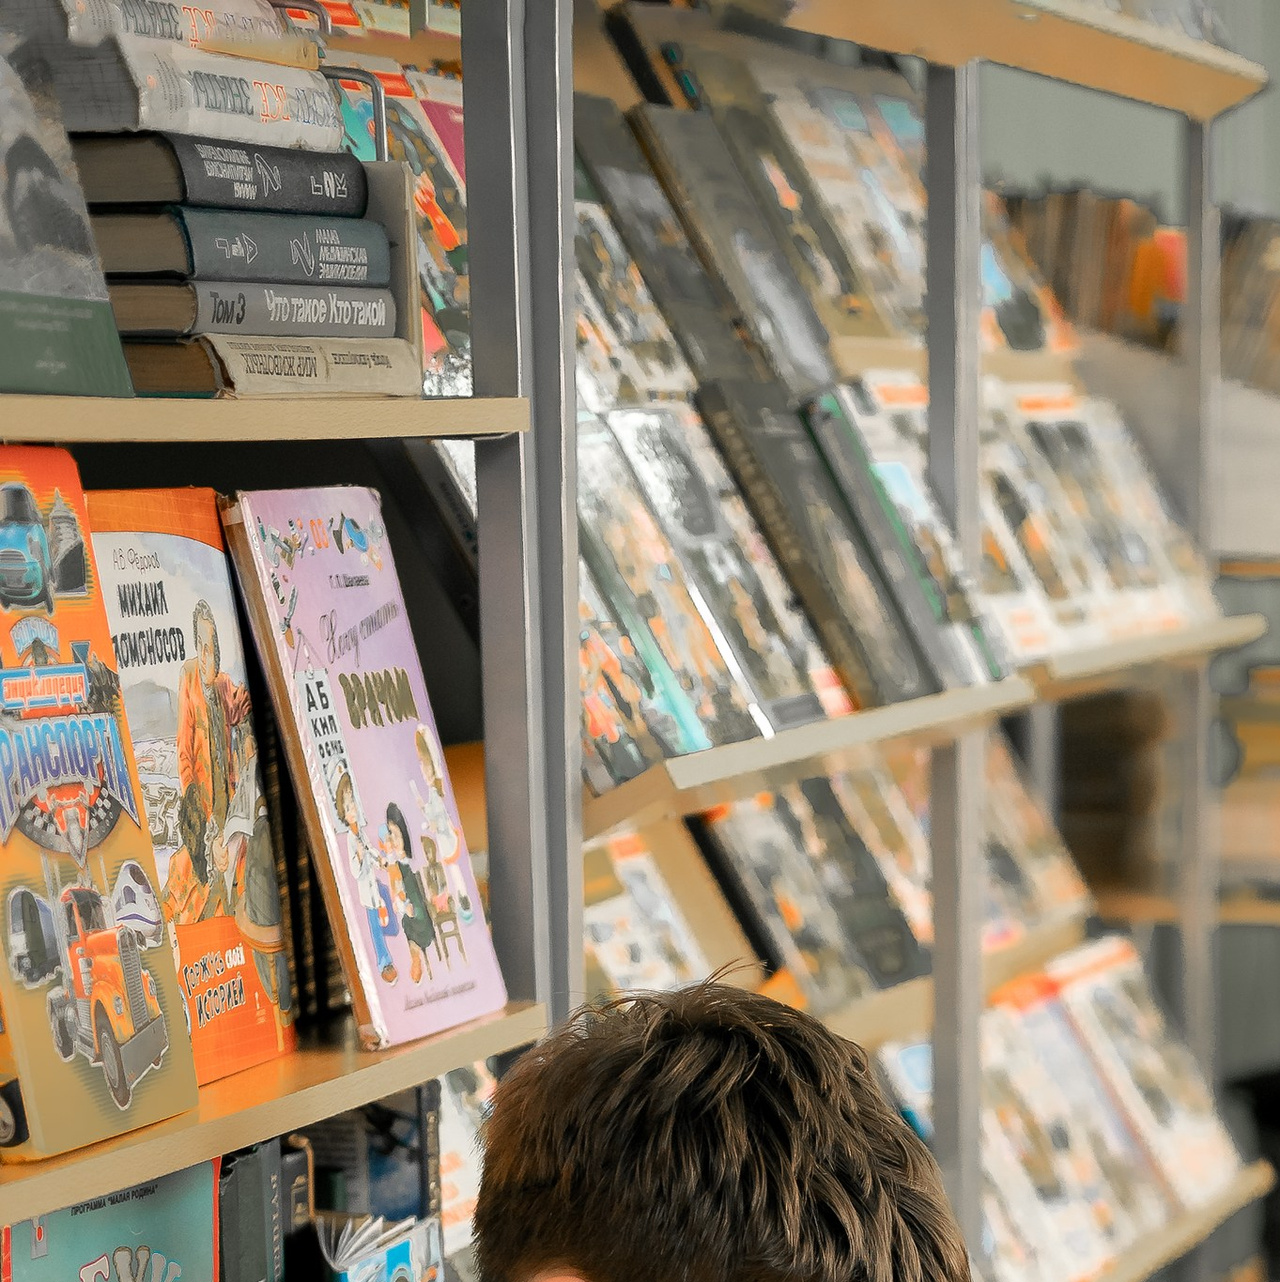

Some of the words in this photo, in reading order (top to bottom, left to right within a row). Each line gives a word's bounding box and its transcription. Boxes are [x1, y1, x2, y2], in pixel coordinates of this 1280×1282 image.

[209, 290, 235, 325] Том
[236, 292, 247, 326] 3
[264, 289, 290, 324] Что
[291, 296, 328, 325] такое
[328, 292, 352, 325] Кто
[352, 298, 386, 327] такой
[240, 352, 296, 377] ЖИВОТНЫХ
[295, 355, 318, 379] МИР
[117, 580, 169, 619] МИХАИЛ
[111, 626, 186, 670] ЛОМОНОСОВ
[194, 970, 247, 1029] ИСТОРИЕЙ
[70, 1198, 108, 1218] ПРОГРАММА
